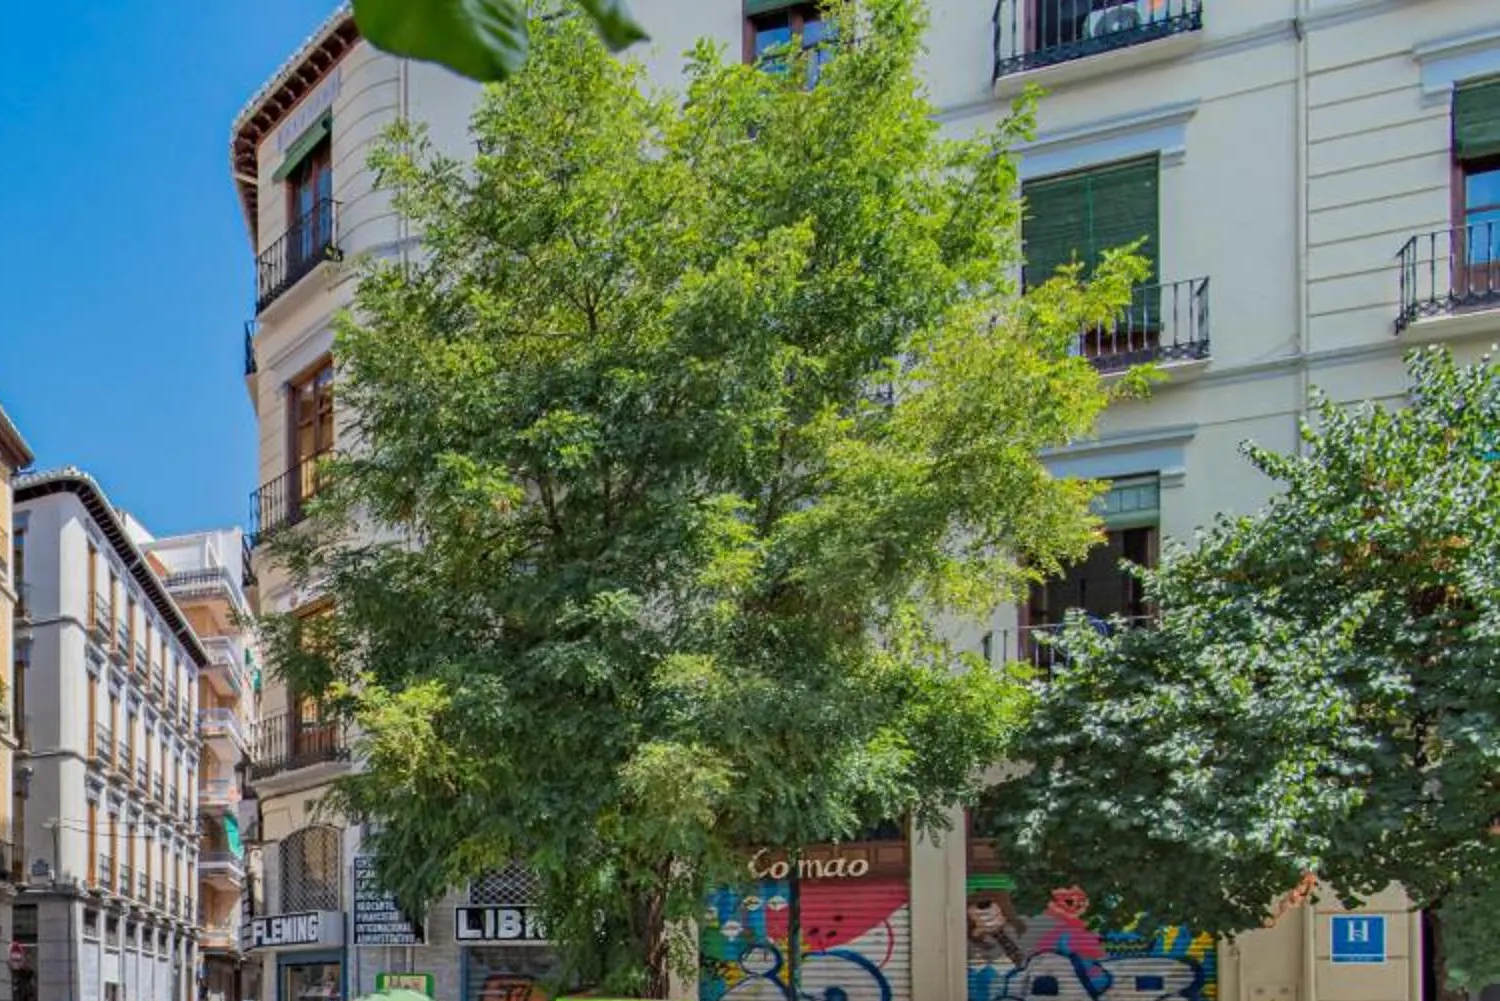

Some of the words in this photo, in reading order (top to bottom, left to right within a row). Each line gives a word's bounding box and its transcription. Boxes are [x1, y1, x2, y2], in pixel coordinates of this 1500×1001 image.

[748, 847, 869, 879] Comao
[252, 914, 318, 945] FLEMING
[457, 908, 548, 939] LIBR
